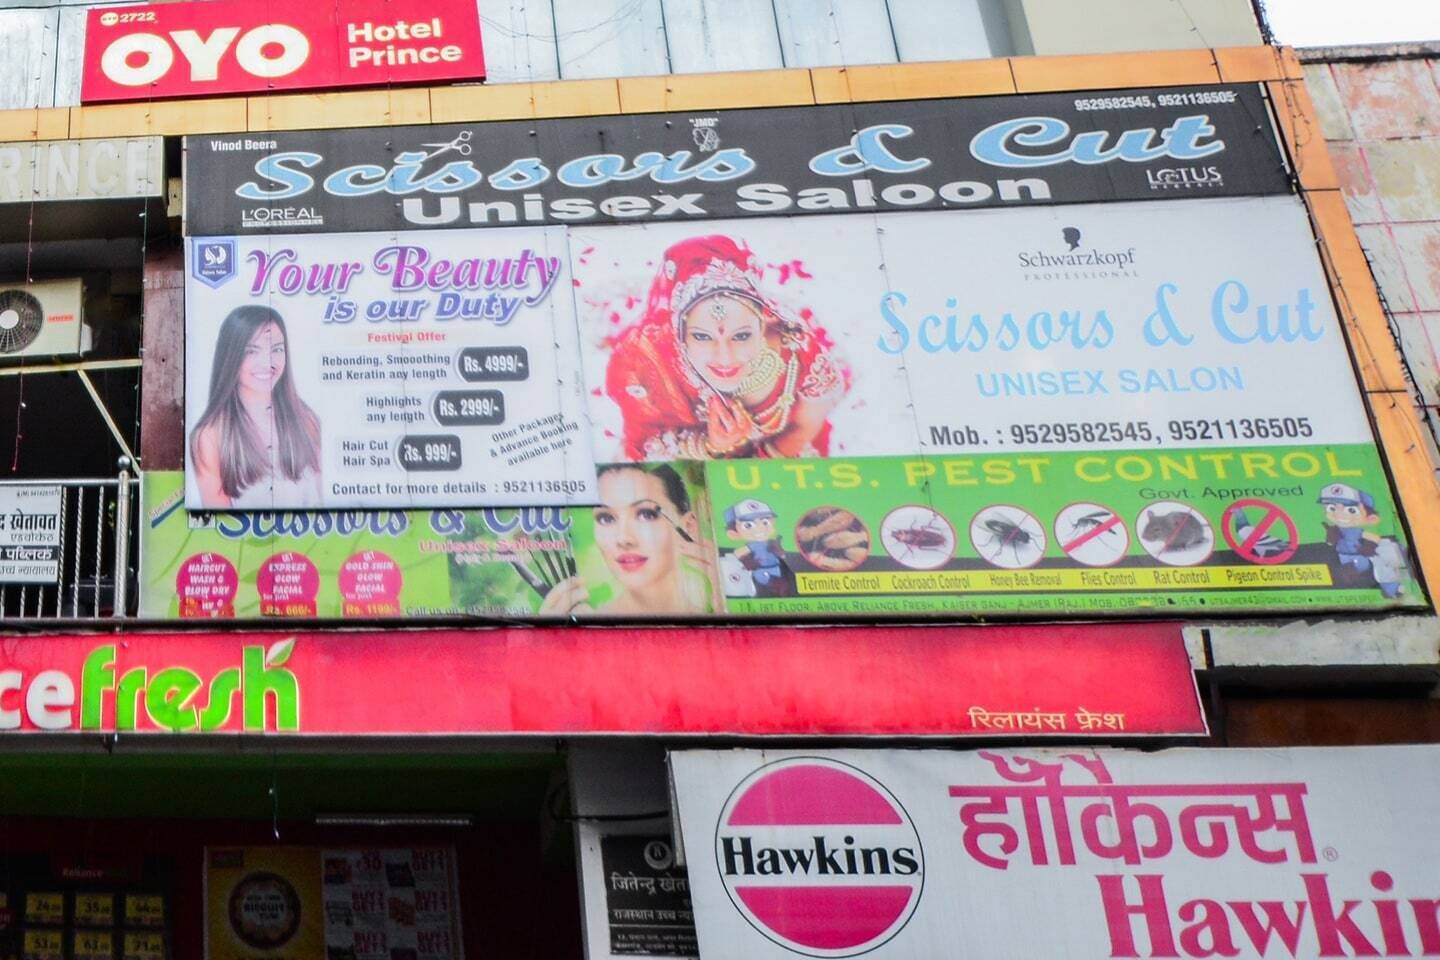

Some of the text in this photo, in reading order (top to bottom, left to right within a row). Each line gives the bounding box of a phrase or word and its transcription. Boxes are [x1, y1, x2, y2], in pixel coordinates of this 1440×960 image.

[120, 12, 156, 23] 2722
[348, 17, 442, 43] Hotel
[101, 23, 310, 86] OYO
[349, 45, 462, 68] Prince
[211, 139, 277, 152] Vinod Beera
[235, 147, 756, 200] Scissors
[969, 115, 1226, 168] Cut
[402, 178, 1052, 225] Unisex Saloon
[1018, 248, 1137, 270] Schwarzkopf
[246, 244, 561, 306] Your Beauty
[1024, 270, 1139, 281] PROFESSIONAL
[323, 292, 521, 325] is our Duty
[876, 290, 1115, 355] Scissors
[1210, 279, 1324, 344] Cut
[368, 331, 446, 344] Festival Offer
[322, 356, 384, 369] Rebonding,
[464, 354, 524, 372] Rs. 4999/-
[322, 368, 448, 382] and Keratin any length
[975, 366, 1245, 397] UNISEX SALON
[366, 396, 422, 409] Highlights
[439, 398, 500, 416] Rs. 2999/-
[366, 410, 425, 424] any length
[492, 413, 564, 442] Other Packages
[930, 416, 1313, 447] Mob. 9529582545, 9521136505
[342, 440, 389, 451] Hair Cut
[500, 421, 579, 455] Advance Booking
[404, 443, 457, 461] Rs. 999/-
[508, 446, 550, 466] available
[343, 456, 391, 468] Hair Spa
[725, 451, 1363, 490] U.T.S. PEST CONTROL
[332, 480, 586, 495] Contact for more details 9521136505
[1138, 484, 1304, 500] Govt. Approved
[802, 574, 881, 591] Termite Control
[891, 573, 971, 591] Cockroach Control
[989, 574, 1013, 590] Honey
[1014, 574, 1028, 587] Bee
[1081, 570, 1137, 586] Flies Control
[1153, 569, 1210, 585] Rat Control
[1226, 568, 1323, 585] Pigeon Control Spike
[79, 643, 300, 732] fresh
[967, 706, 1125, 730] रिलायंस फ्रेश
[720, 835, 919, 876] Hawkins
